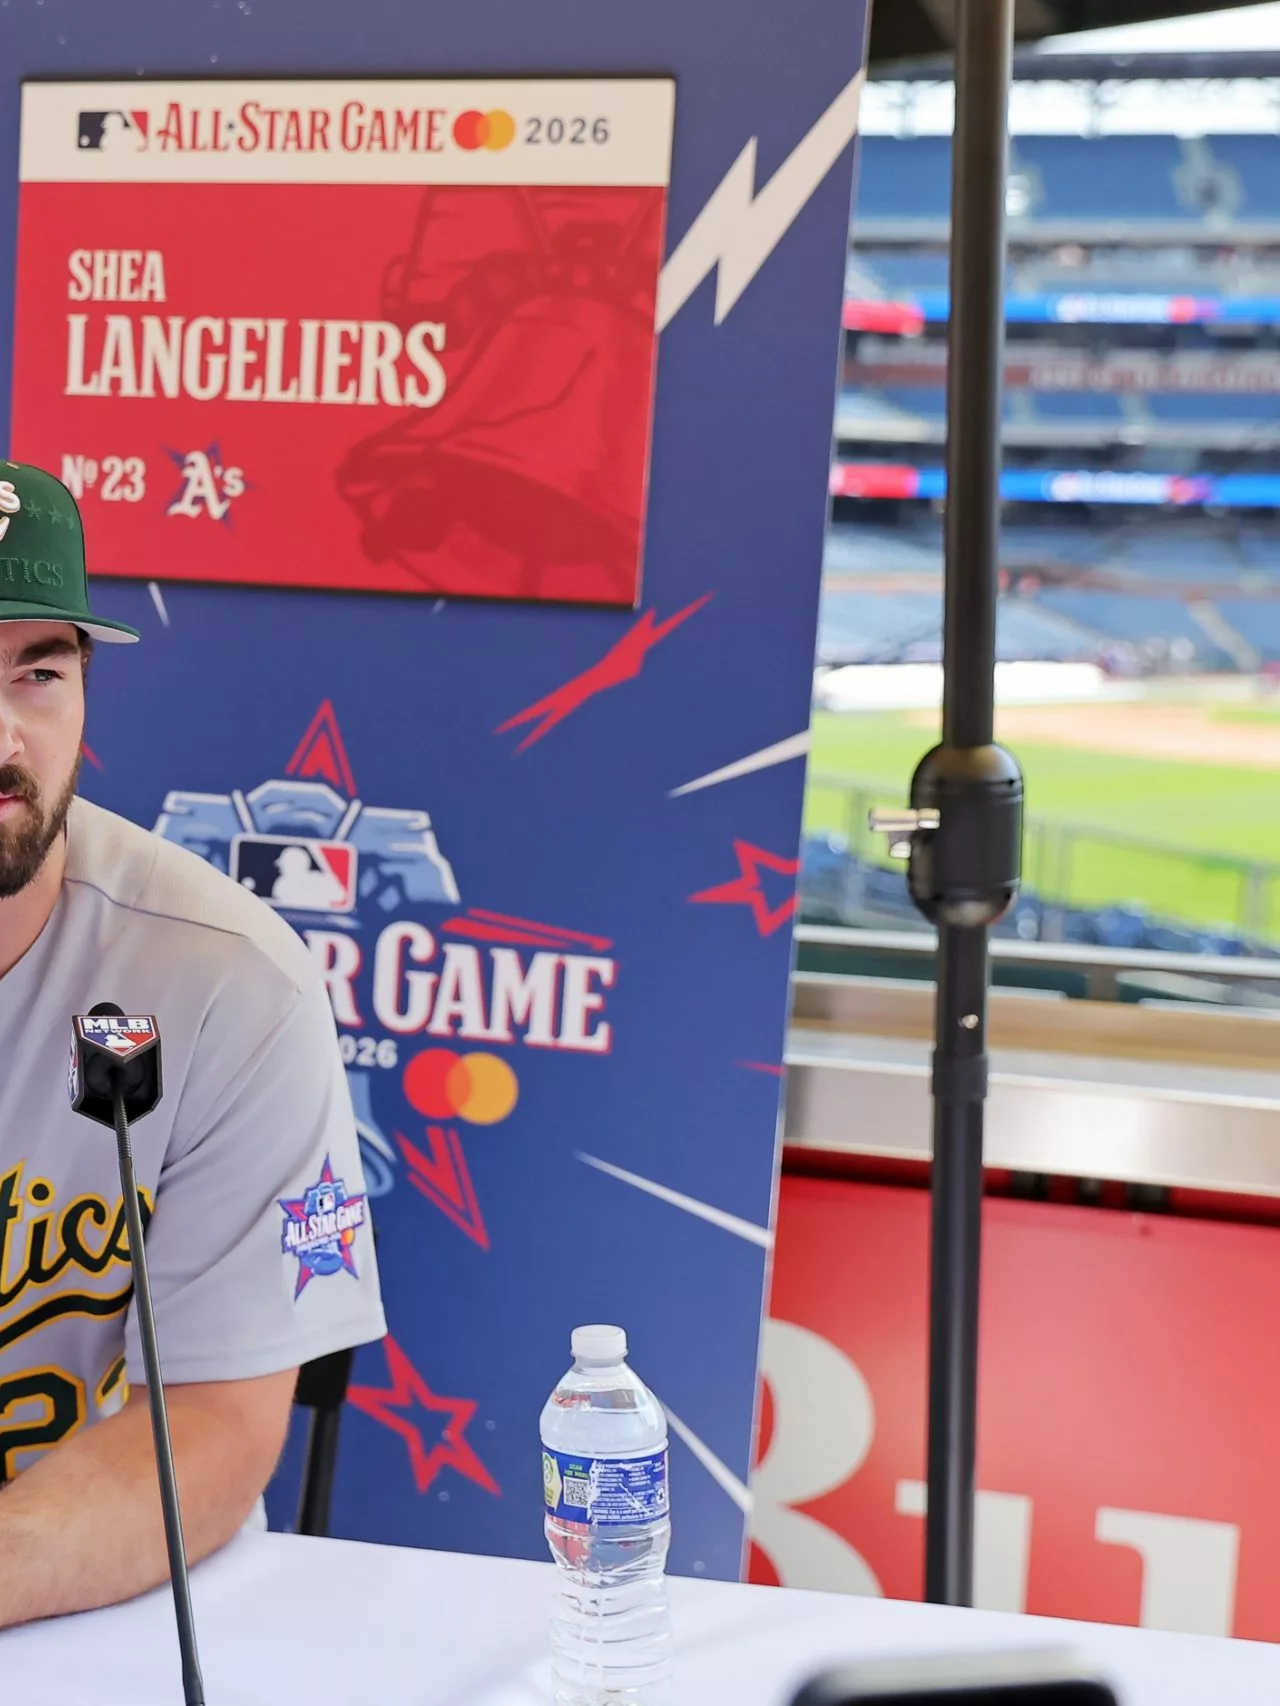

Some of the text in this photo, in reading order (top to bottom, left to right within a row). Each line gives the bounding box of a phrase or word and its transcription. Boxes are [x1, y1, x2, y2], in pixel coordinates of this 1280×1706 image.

[339, 100, 447, 153] GAME
[525, 116, 611, 146] 2026
[67, 248, 167, 303] SHEA
[64, 313, 448, 409] LANGELIERS
[101, 455, 146, 502] 23
[373, 920, 618, 1056] GAME
[82, 1018, 151, 1030] MLB
[337, 1034, 398, 1069] 026
